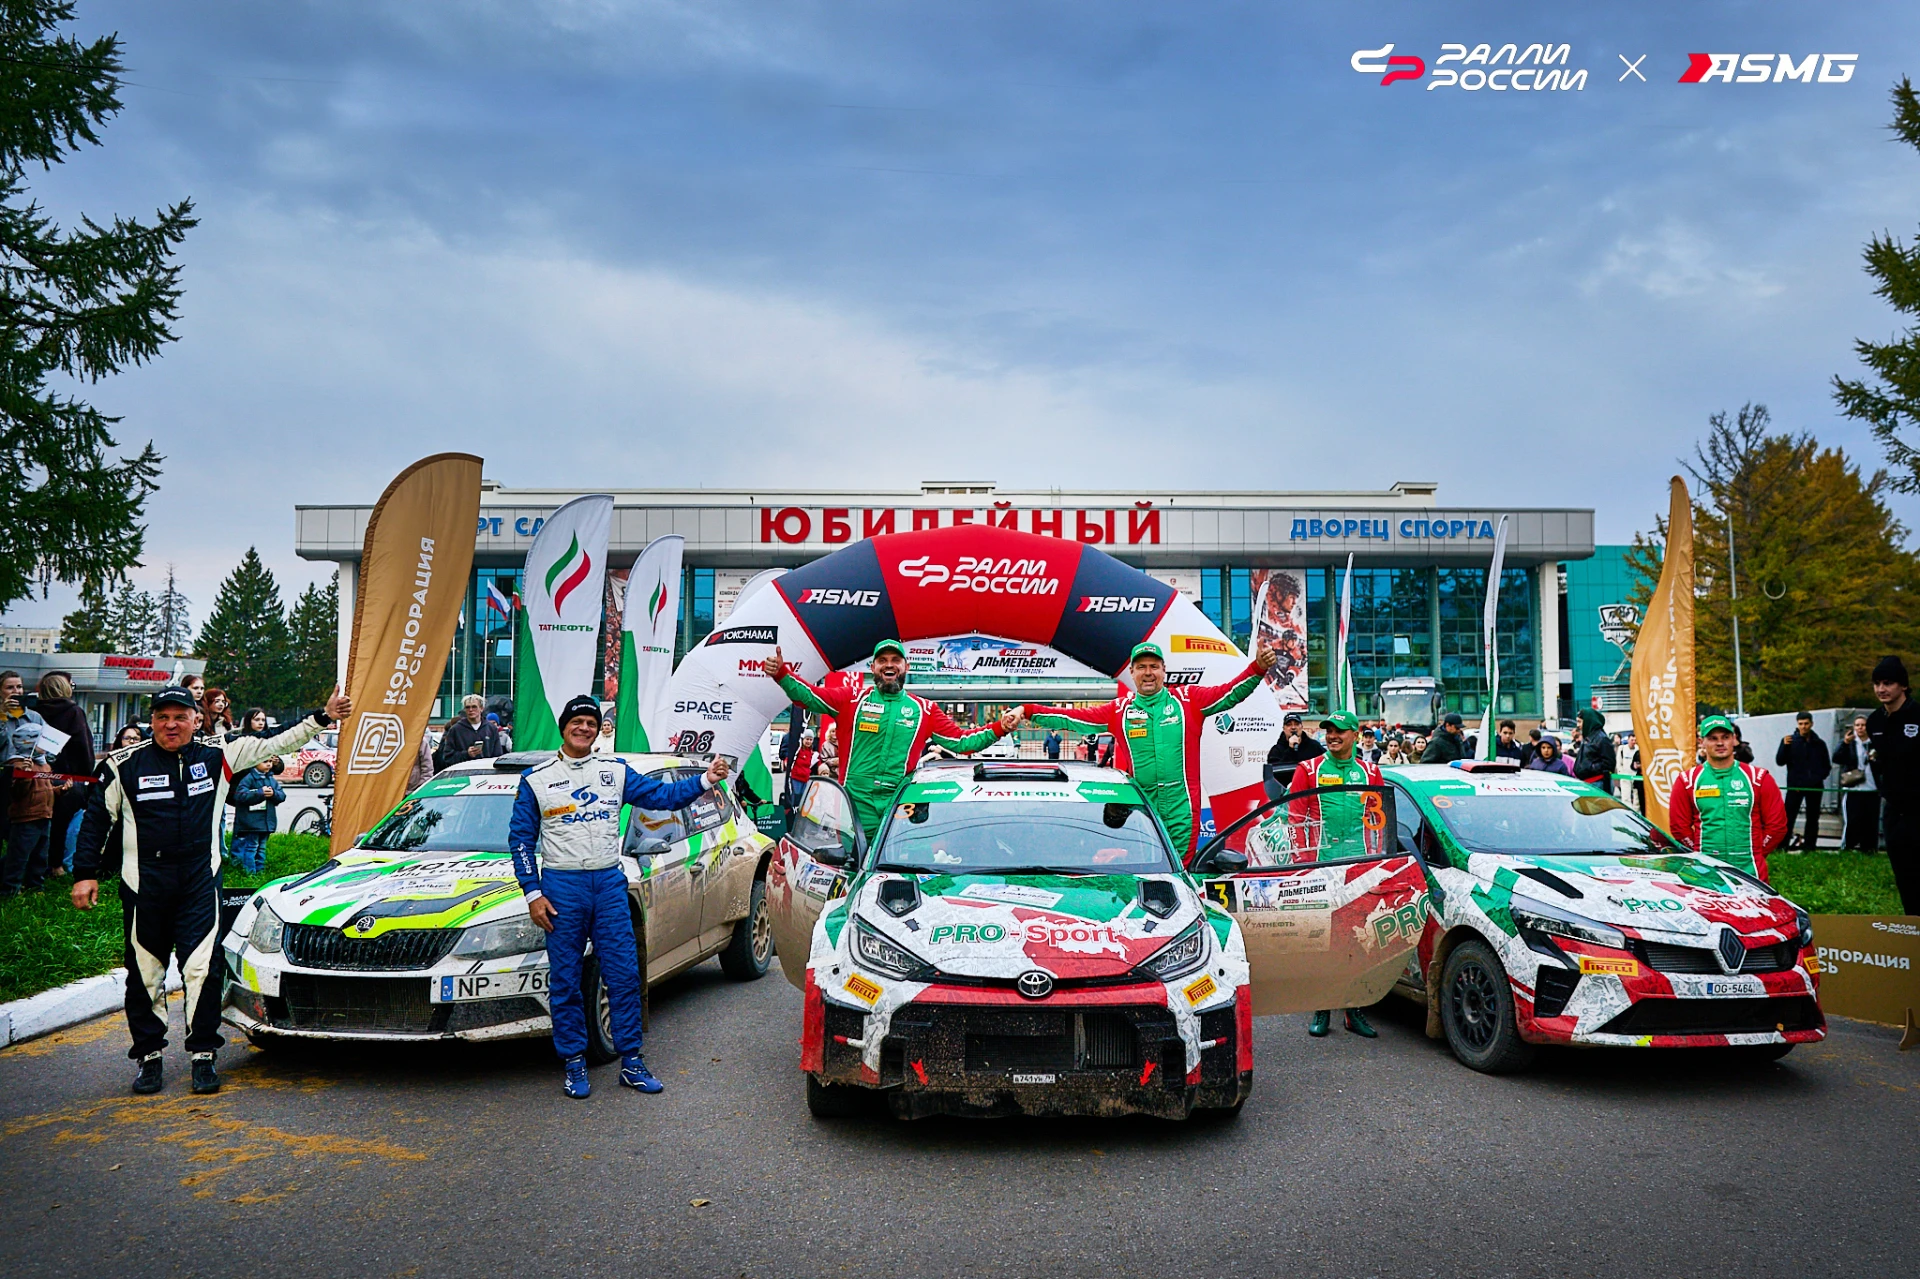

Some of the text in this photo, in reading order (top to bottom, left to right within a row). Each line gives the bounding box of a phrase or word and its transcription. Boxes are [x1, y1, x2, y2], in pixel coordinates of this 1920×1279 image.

[1289, 518, 1495, 540] ДВОРЕЦ СПОРТА
[957, 557, 1047, 576] РАЛЛИ
[949, 575, 1058, 595] РОССИИ
[808, 588, 881, 606] ASMG
[1085, 597, 1156, 613] ASMG
[383, 537, 435, 705] КОРПОРАЦИЯ
[538, 623, 594, 632] ТАТНЕФТЬ
[723, 629, 774, 640] YOKOHAMA
[1186, 638, 1228, 652] PIRELLI
[104, 656, 154, 668] МАГАЗИН
[972, 656, 1057, 670] АЛЬМЕТЬЕВСК
[397, 643, 427, 705] РУСЬ
[674, 701, 733, 714] SPACE
[702, 713, 732, 721] TRAVEL
[1432, 795, 1453, 809] 6
[561, 810, 610, 825] SACHS
[894, 803, 915, 819] 3
[1361, 791, 1387, 831] 3
[391, 859, 514, 875] MOTOR
[1214, 884, 1228, 909] 3
[1278, 885, 1327, 900] АЛЬМЕТЬЕВСК
[1583, 958, 1634, 973] PIRELLI
[1815, 947, 1910, 970] РПОРАЦИЯ
[1819, 962, 1839, 974] СЬ
[847, 976, 880, 1000] PIRELLI
[1187, 978, 1215, 1004] PIRELLI
